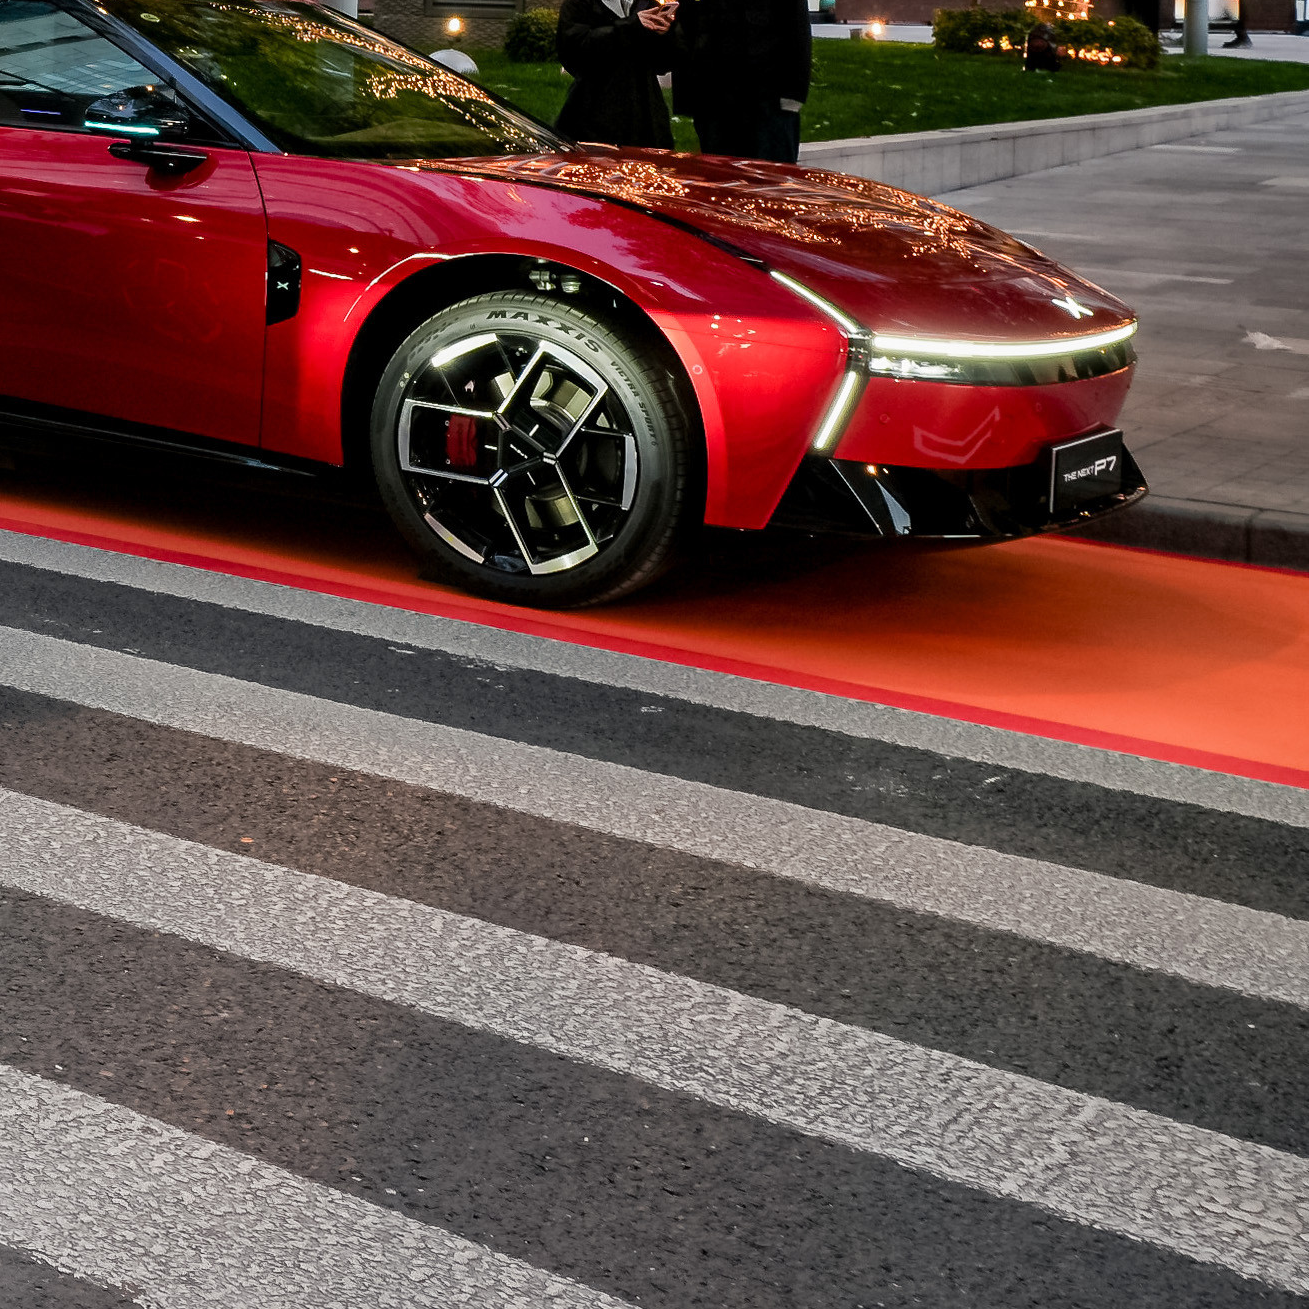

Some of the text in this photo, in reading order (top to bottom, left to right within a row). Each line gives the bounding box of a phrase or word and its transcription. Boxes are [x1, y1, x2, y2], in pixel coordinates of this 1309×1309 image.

[486, 309, 602, 353] MAXXIS
[610, 360, 639, 399] VICTRA
[638, 401, 656, 437] SPORT
[1063, 455, 1117, 482] THE NEXT P7
